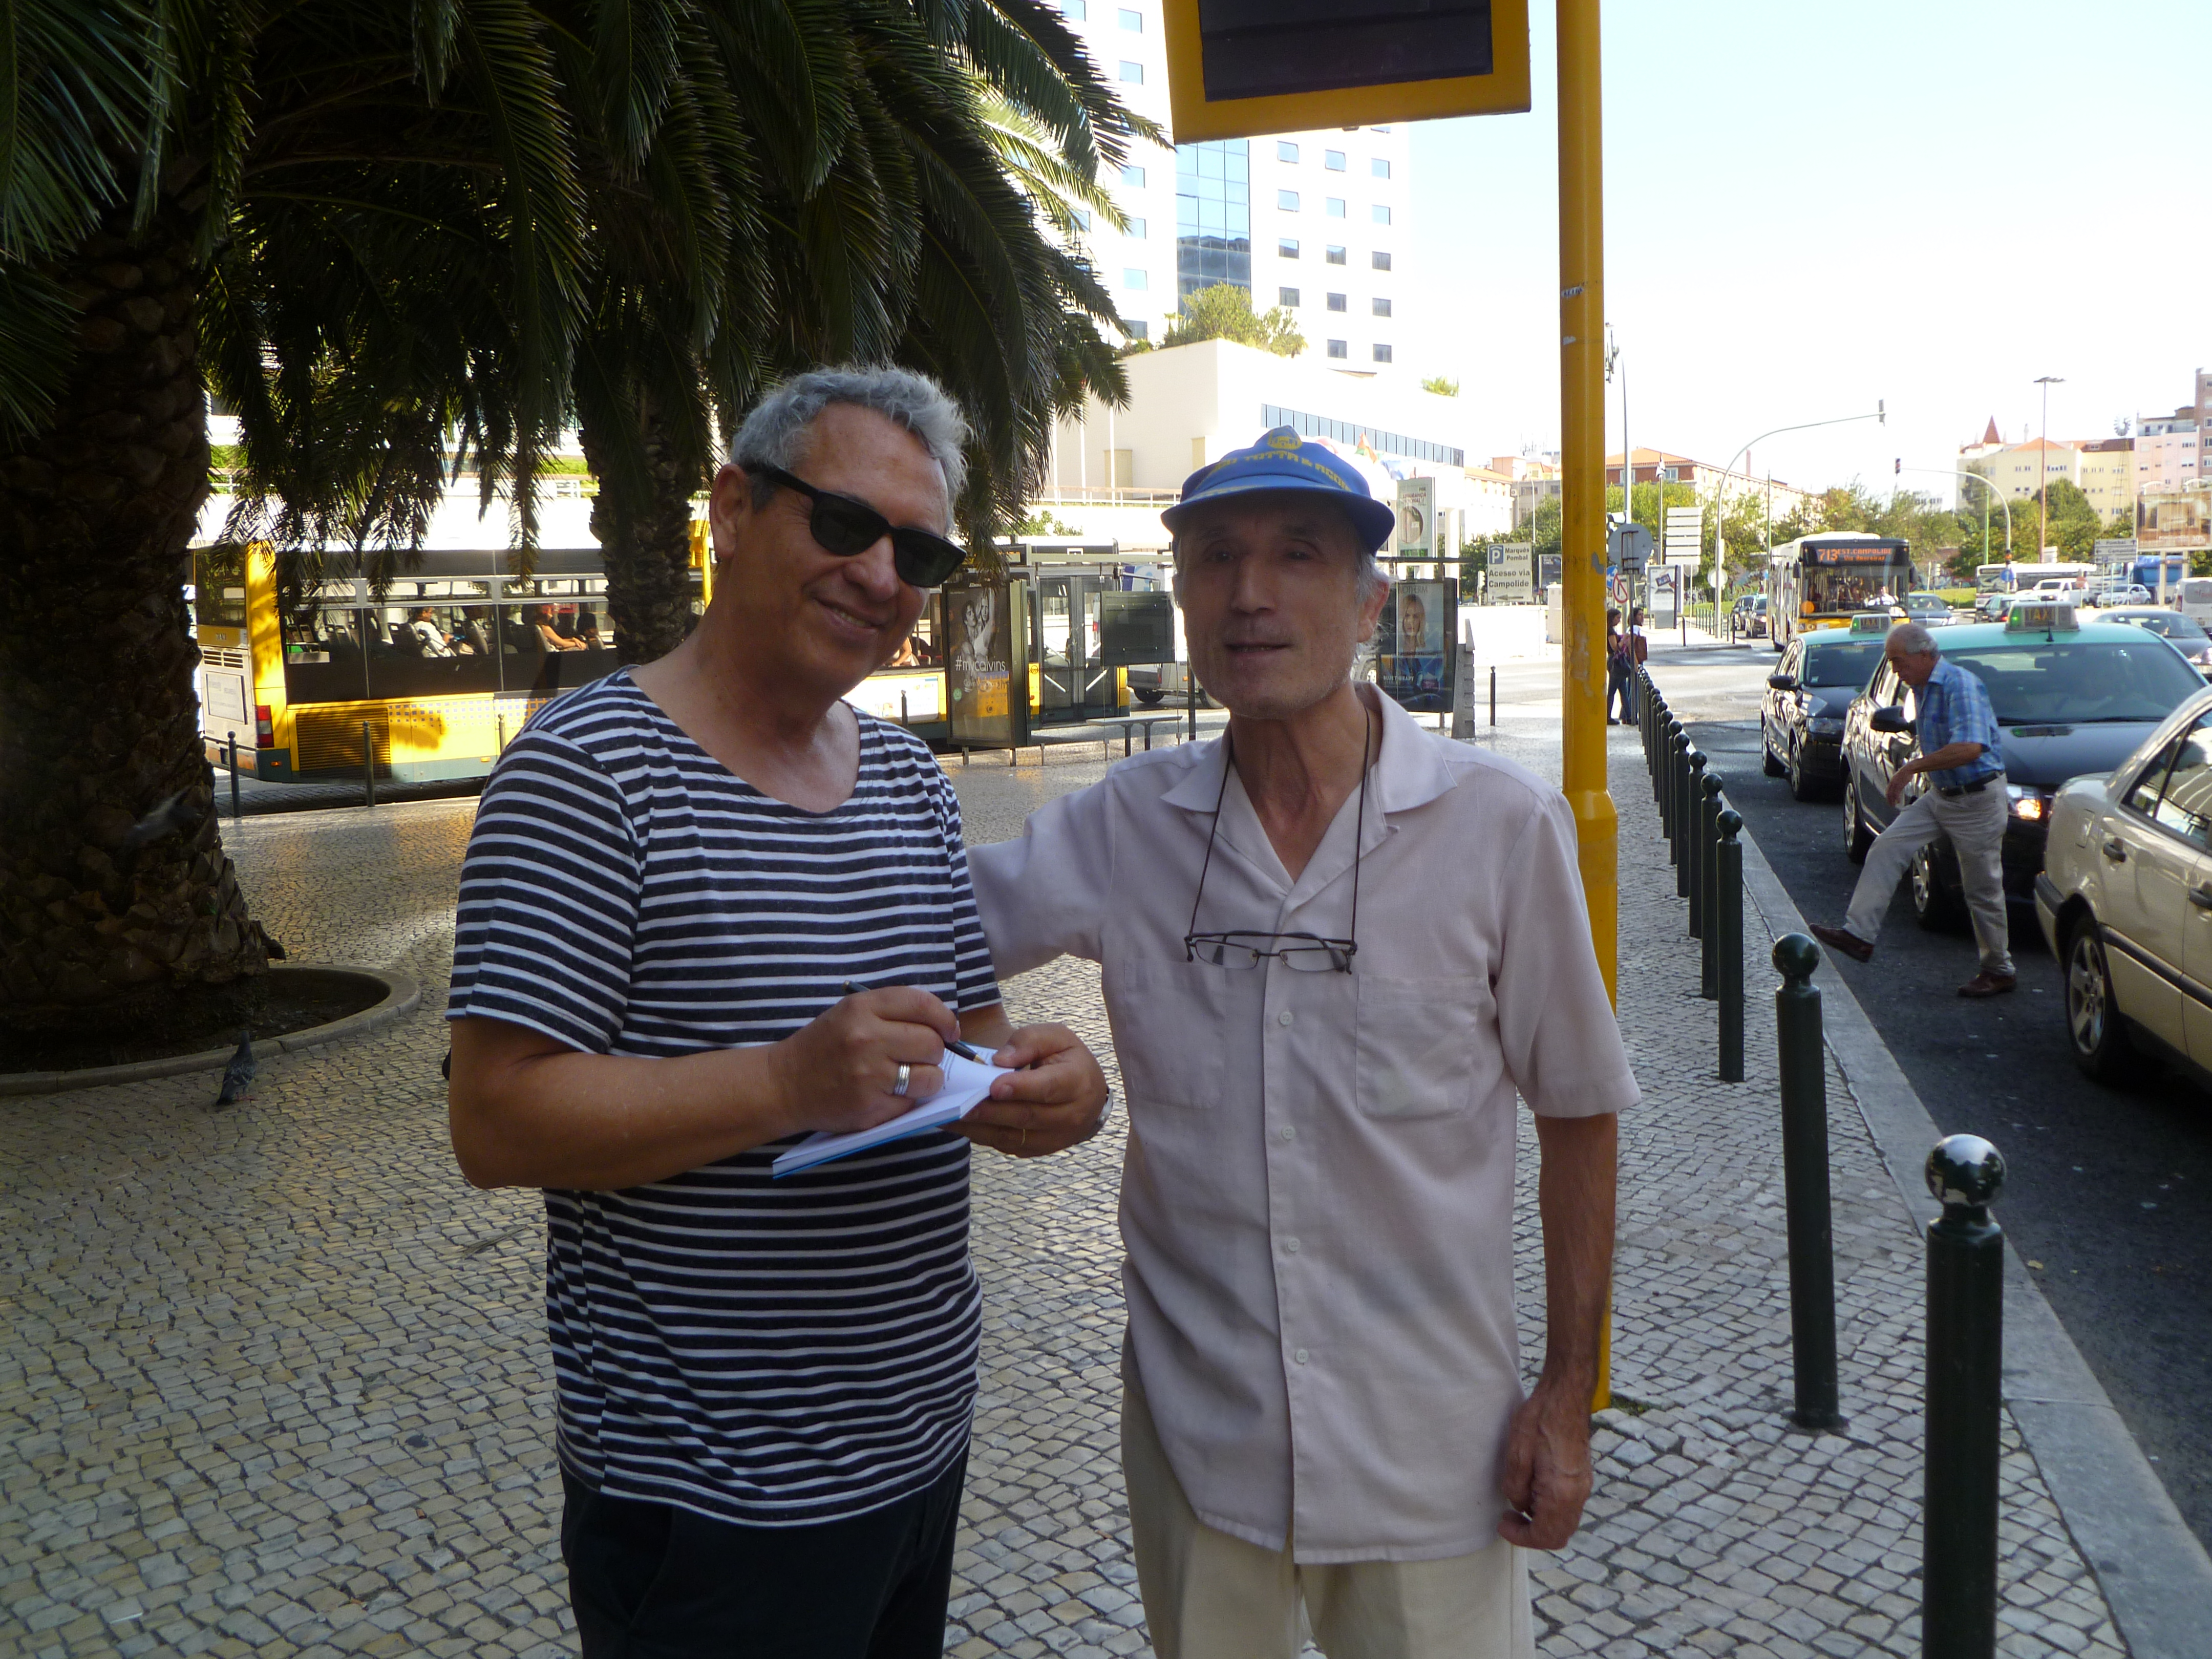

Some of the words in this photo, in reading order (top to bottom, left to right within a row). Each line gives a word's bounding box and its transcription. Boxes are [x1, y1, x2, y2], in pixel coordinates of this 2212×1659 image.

[1818, 548, 1838, 561] 713
[1488, 580, 1529, 588] Campolide
[2027, 608, 2055, 621] TAXI
[955, 655, 1006, 675] #mycalvins
